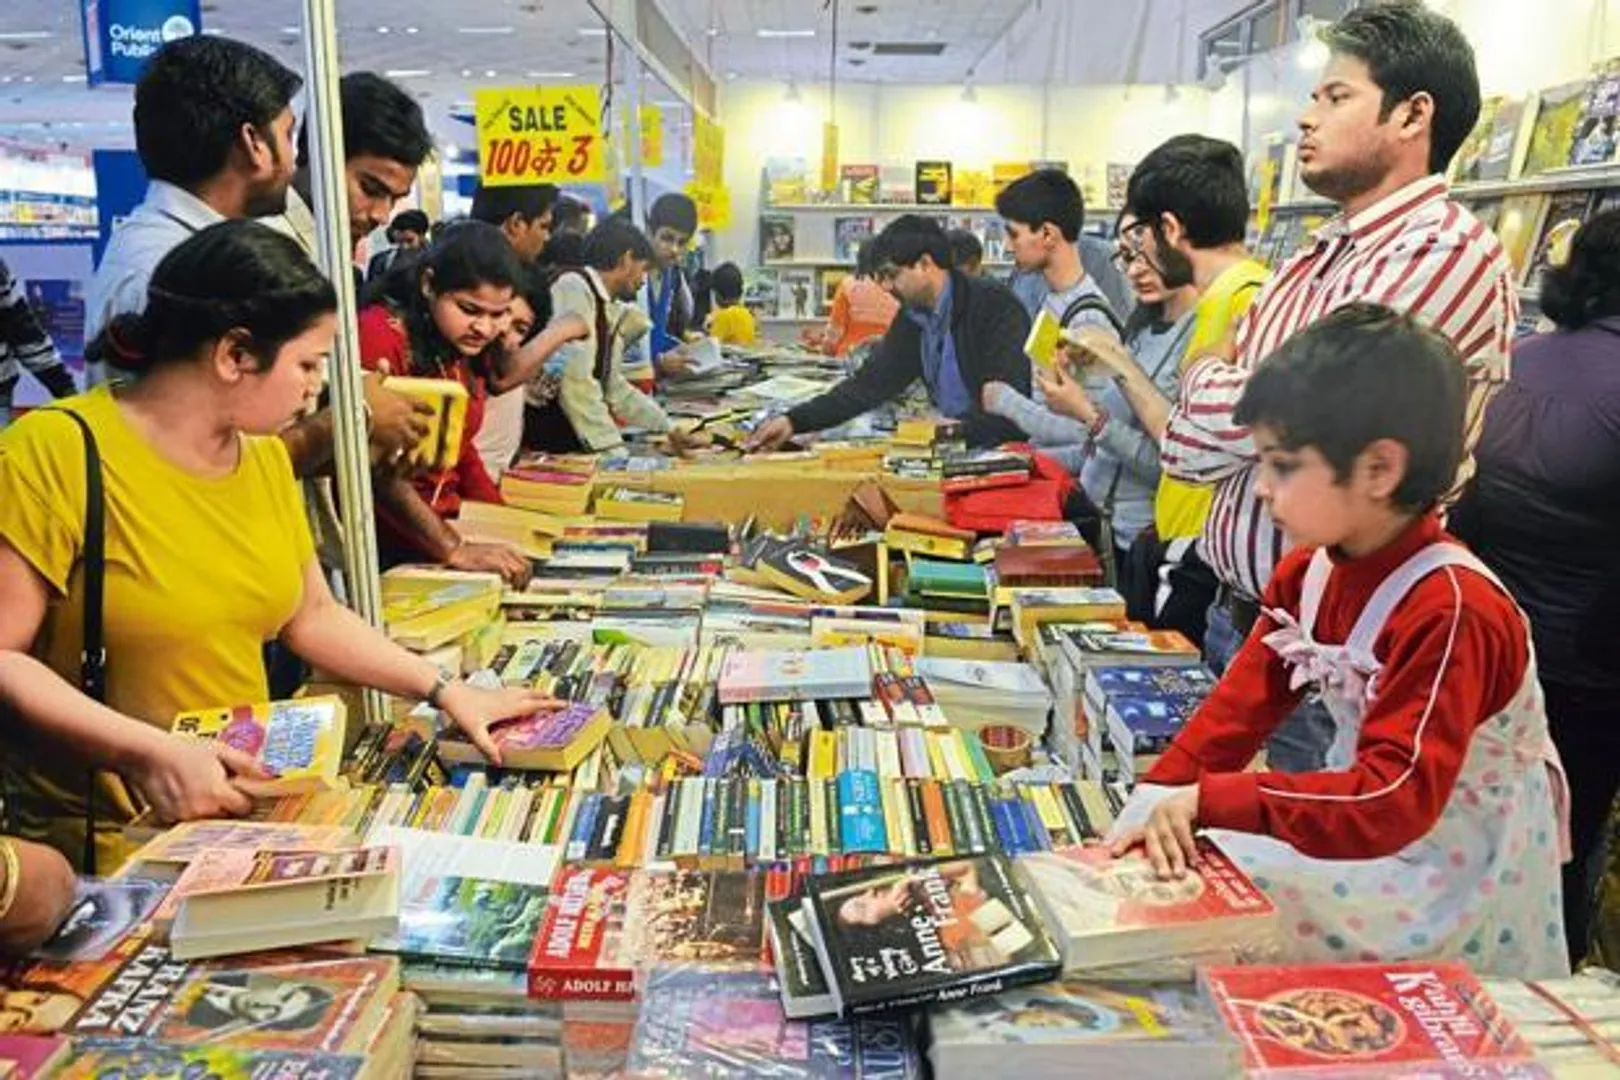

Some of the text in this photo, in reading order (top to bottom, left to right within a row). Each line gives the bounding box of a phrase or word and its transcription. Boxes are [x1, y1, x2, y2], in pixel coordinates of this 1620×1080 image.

[109, 23, 161, 42] Orient
[509, 105, 567, 132] SALE
[486, 138, 530, 176] 100
[567, 134, 593, 175] 3
[911, 914, 953, 974] Anne
[76, 945, 169, 1029] KAFKA
[111, 963, 189, 1034] RANZ
